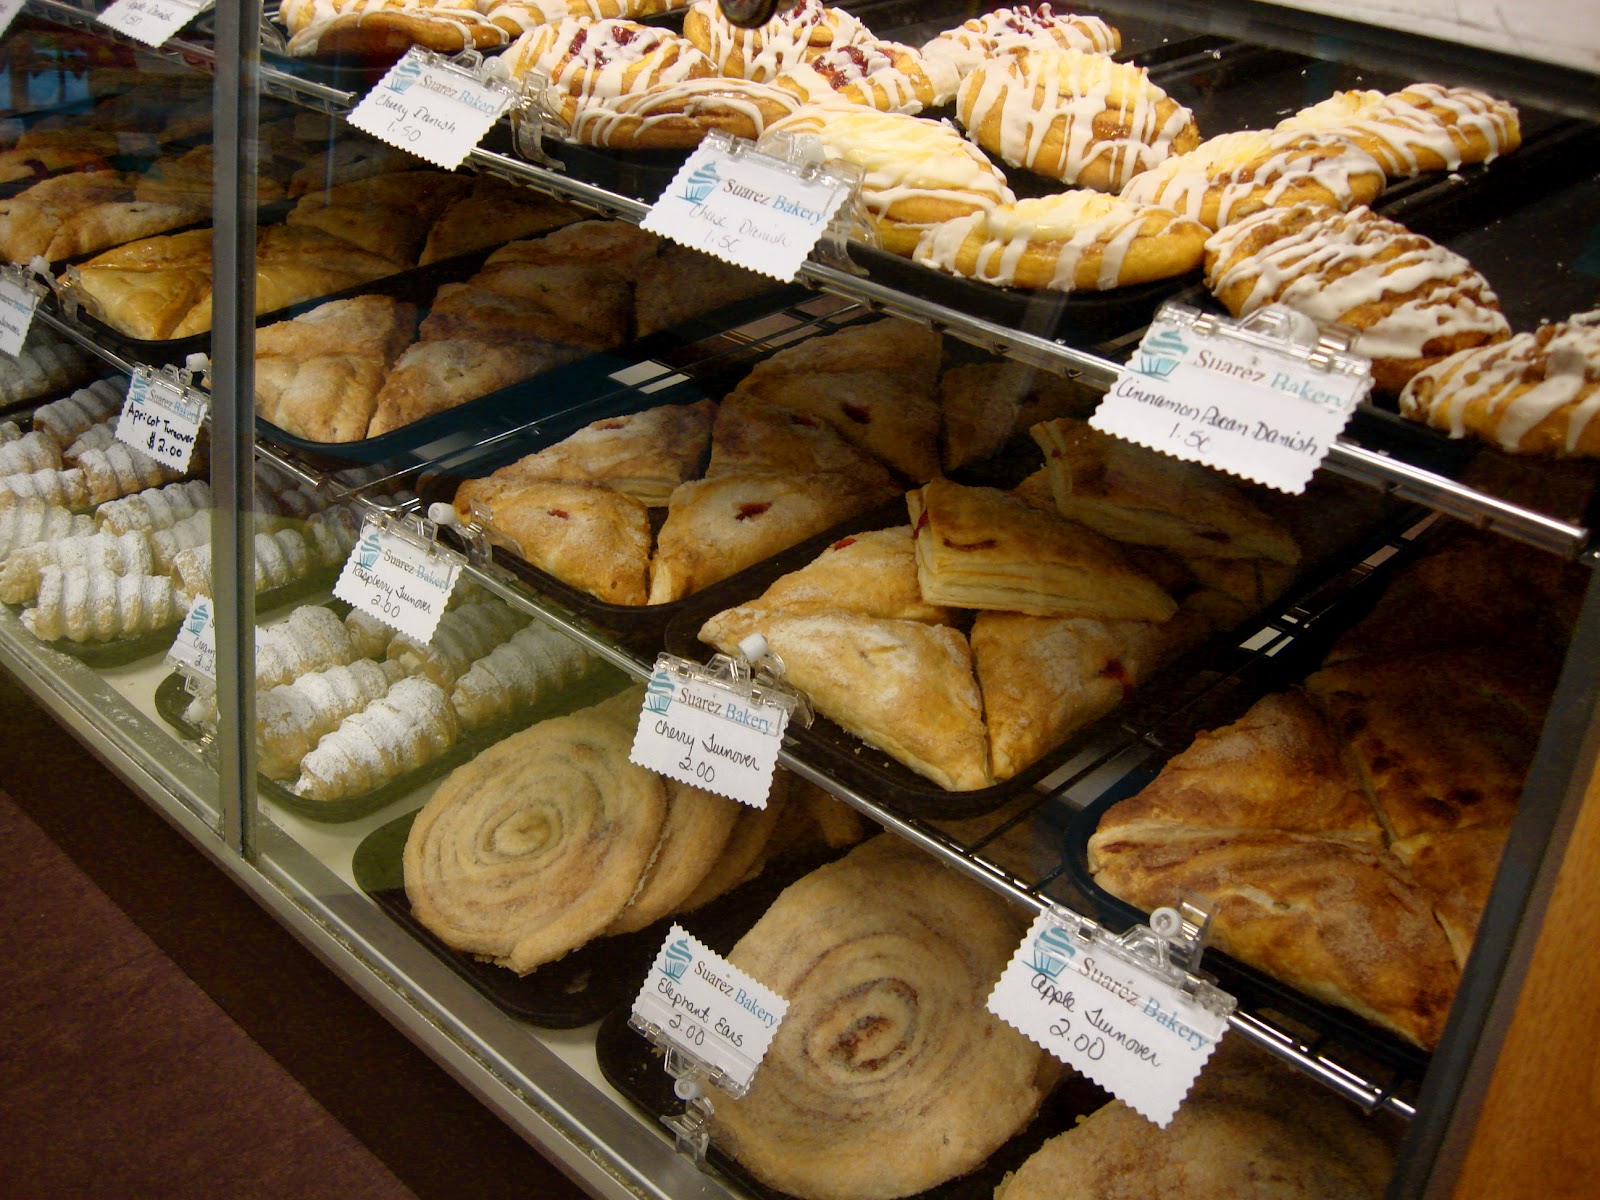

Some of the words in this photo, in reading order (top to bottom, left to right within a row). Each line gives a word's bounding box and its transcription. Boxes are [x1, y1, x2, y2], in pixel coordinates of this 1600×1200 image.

[419, 75, 458, 97] Suarez
[459, 90, 496, 118] Bakery
[386, 121, 422, 142] 1.50
[413, 106, 456, 134] Danish
[722, 178, 771, 206] Suarez
[772, 195, 827, 227] Bakery
[150, 389, 173, 408] Suarez
[1193, 349, 1266, 382] Suarez
[1270, 371, 1345, 415] Bakery
[126, 402, 161, 427] Apricot
[1116, 377, 1200, 422] Cinnamon
[1253, 420, 1319, 456] Danish
[383, 549, 415, 575] Suarez
[416, 565, 452, 594] Bakery
[371, 594, 401, 618] 2.00
[678, 687, 722, 715] Suarez
[725, 703, 773, 734] Bakery
[655, 720, 695, 756] Cherry
[678, 757, 715, 782] 2.00
[657, 977, 711, 1023] Elephant
[714, 1017, 744, 1047] Ears
[694, 960, 734, 997] Suarez
[734, 988, 778, 1029] Bakery
[1078, 957, 1138, 1007] Suarez
[1141, 996, 1208, 1052] Bakery
[668, 1014, 705, 1046] 2.00
[1049, 1018, 1106, 1061] 2.00
